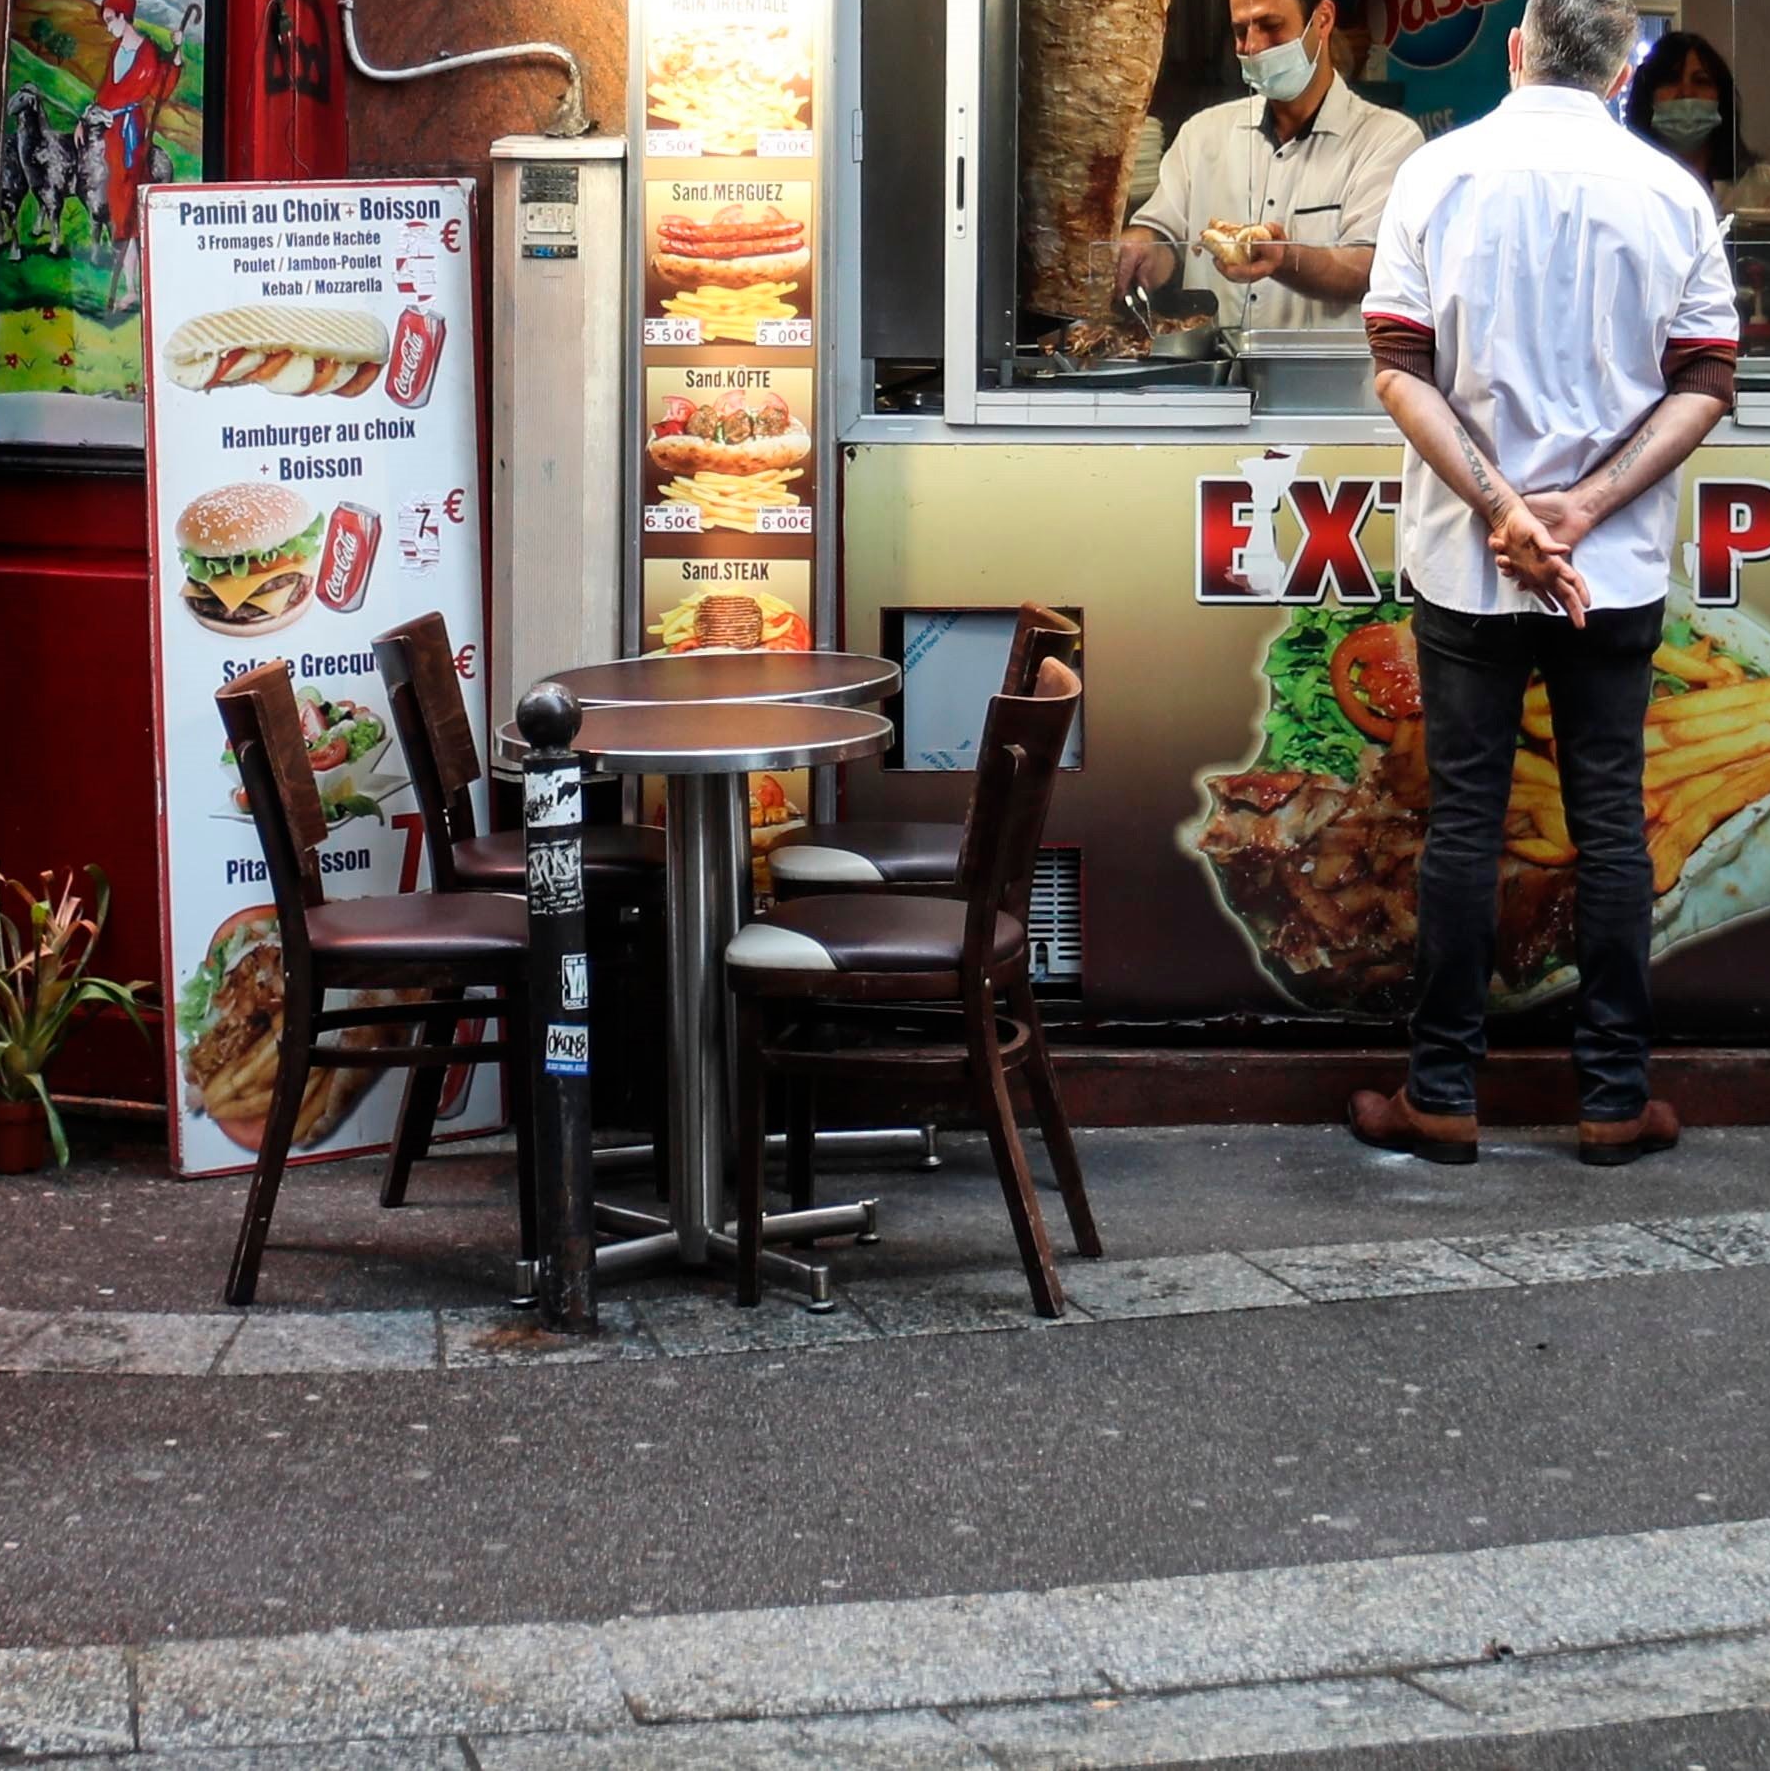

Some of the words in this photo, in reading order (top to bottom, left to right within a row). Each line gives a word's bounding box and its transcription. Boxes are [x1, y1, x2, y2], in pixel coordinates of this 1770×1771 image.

[179, 199, 247, 226] Panini
[252, 202, 279, 224] au
[283, 196, 342, 224] Choix
[359, 196, 441, 222] Boisson
[197, 236, 206, 251] 3
[208, 232, 274, 253] Fromages
[285, 230, 331, 249] Viande
[333, 229, 382, 247] Hachée
[222, 424, 333, 451] Hamburger
[337, 423, 361, 443] au
[364, 416, 417, 442] choix
[279, 455, 364, 482] Boisson
[226, 857, 266, 886] Pita
